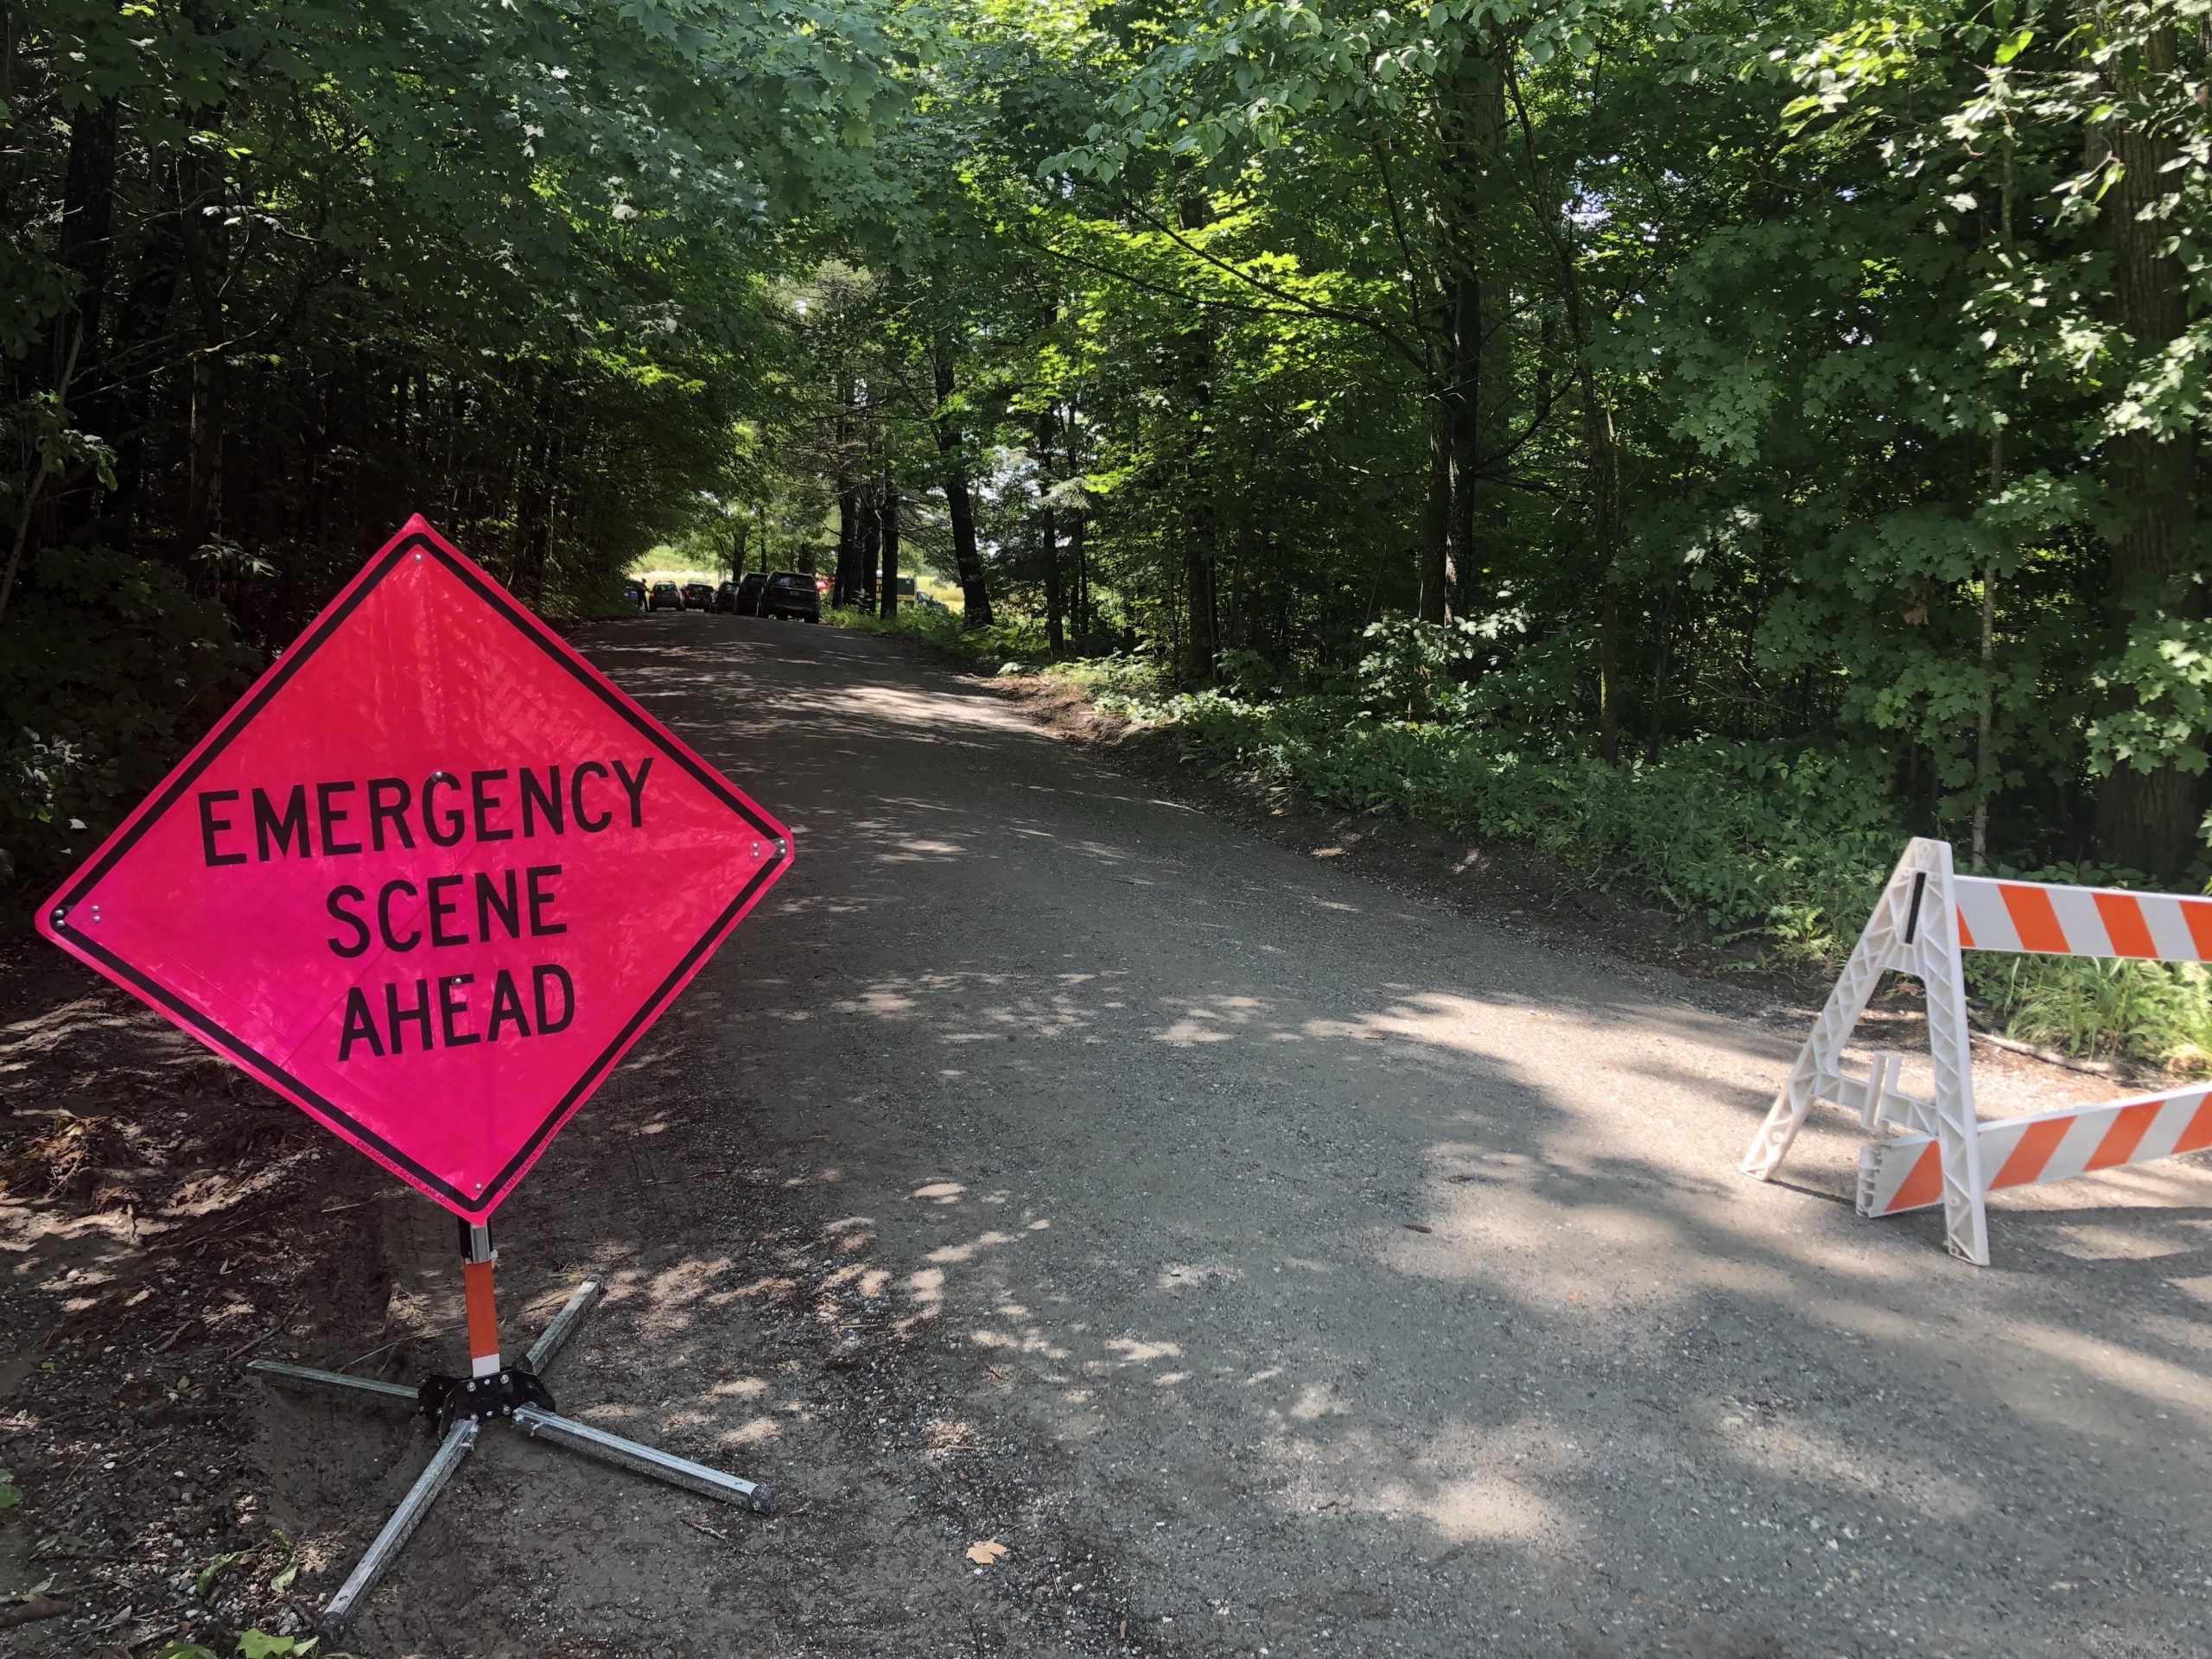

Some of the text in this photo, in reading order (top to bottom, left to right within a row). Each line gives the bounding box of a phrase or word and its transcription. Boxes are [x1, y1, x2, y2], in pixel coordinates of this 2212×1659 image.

[199, 758, 652, 867] EMERGENCY
[327, 865, 567, 958] SCENE
[339, 963, 575, 1060] AHEAD
[355, 1139, 447, 1204] EMERGENCY SCENE AHEAD
[502, 1153, 537, 1192] EMERGENCY
[556, 1107, 575, 1128] AHEAD
